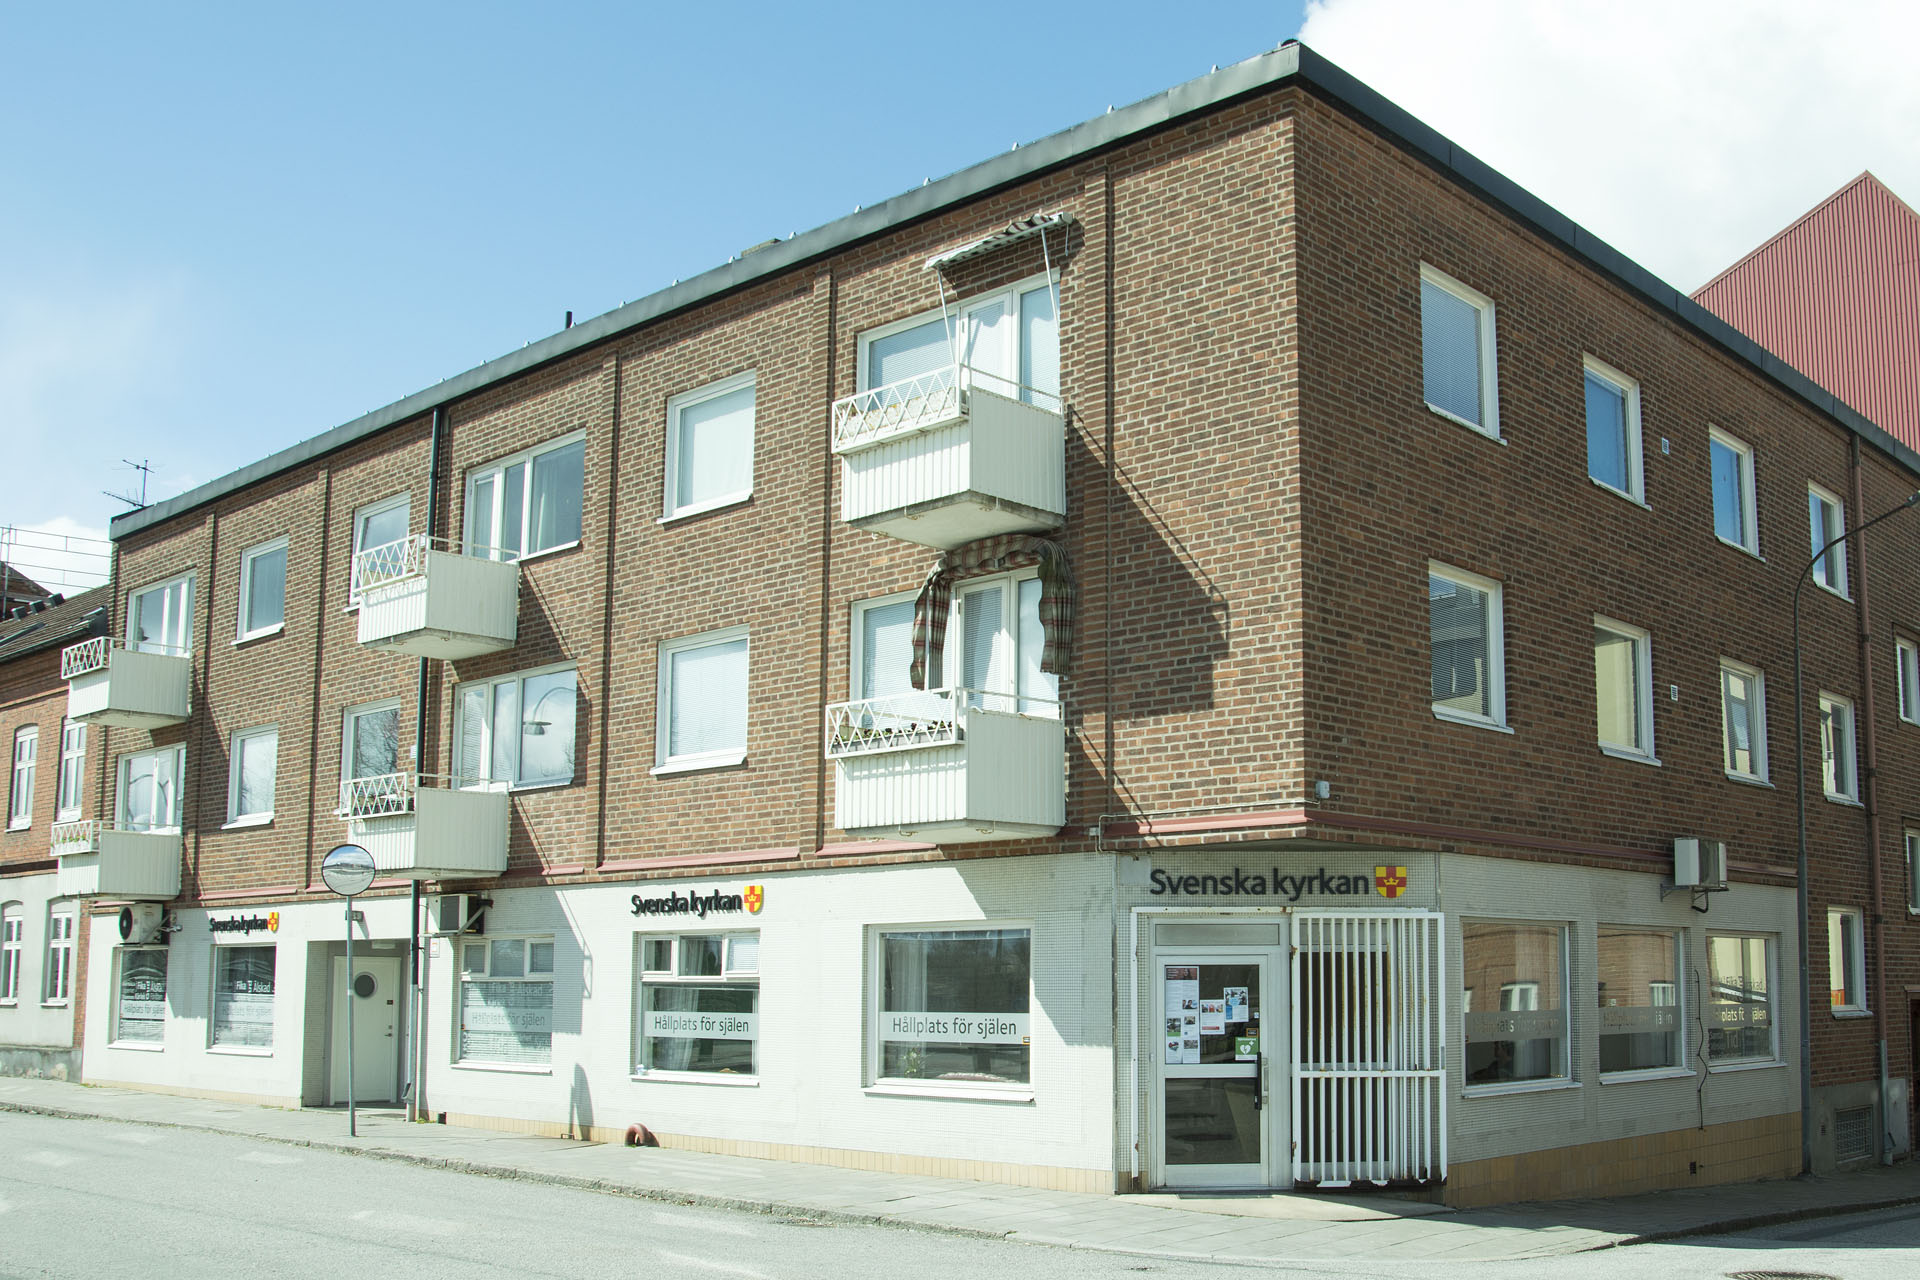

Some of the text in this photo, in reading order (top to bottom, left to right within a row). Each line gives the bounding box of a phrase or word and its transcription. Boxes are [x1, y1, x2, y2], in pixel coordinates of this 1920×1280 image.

[1150, 867, 1370, 902] Svenska kyrkan
[630, 888, 743, 918] Svenska kyrkan
[209, 913, 268, 936] Svenska kyrkan
[521, 1012, 545, 1029] själen
[654, 1014, 749, 1036] Hållplats för själen
[892, 1015, 1017, 1039] Hållplats för själen
